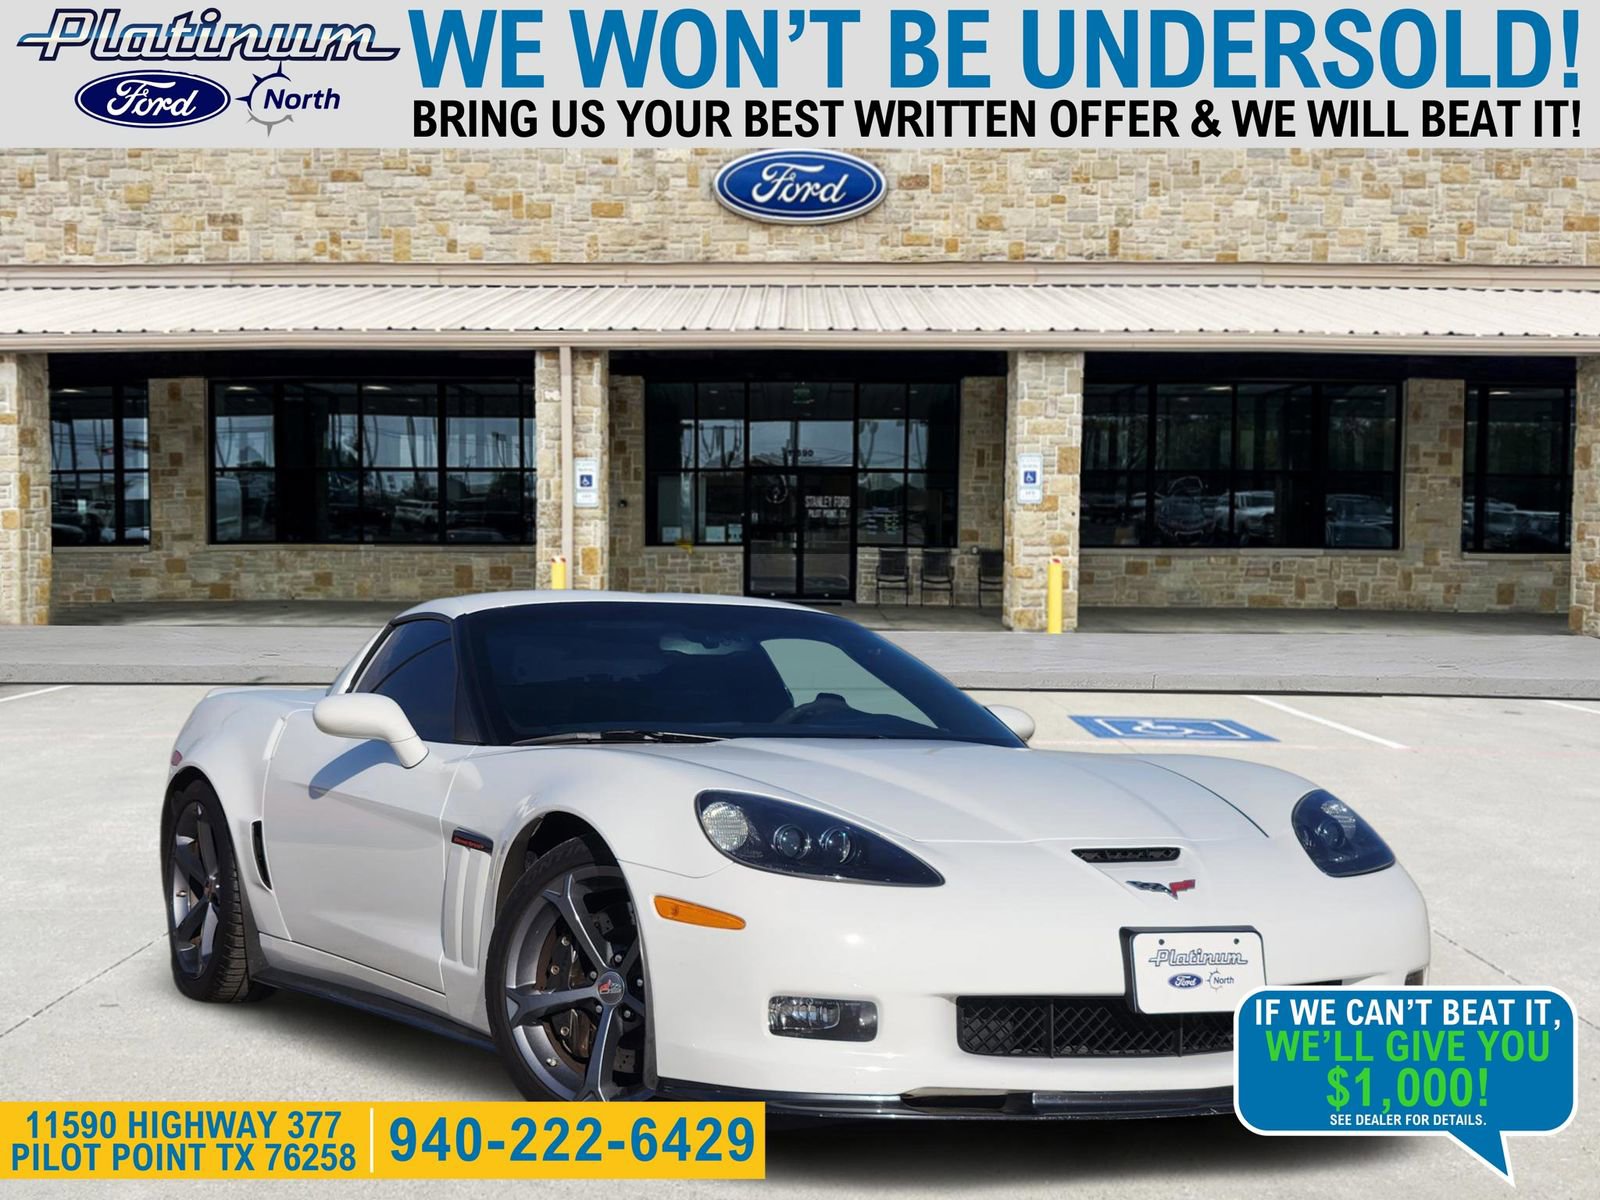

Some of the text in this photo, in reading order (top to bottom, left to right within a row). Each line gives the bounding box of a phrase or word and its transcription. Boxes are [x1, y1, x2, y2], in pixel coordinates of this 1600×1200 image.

[752, 162, 849, 203] Ford
[1148, 948, 1248, 967] Platinum
[1174, 973, 1235, 988] Ford North
